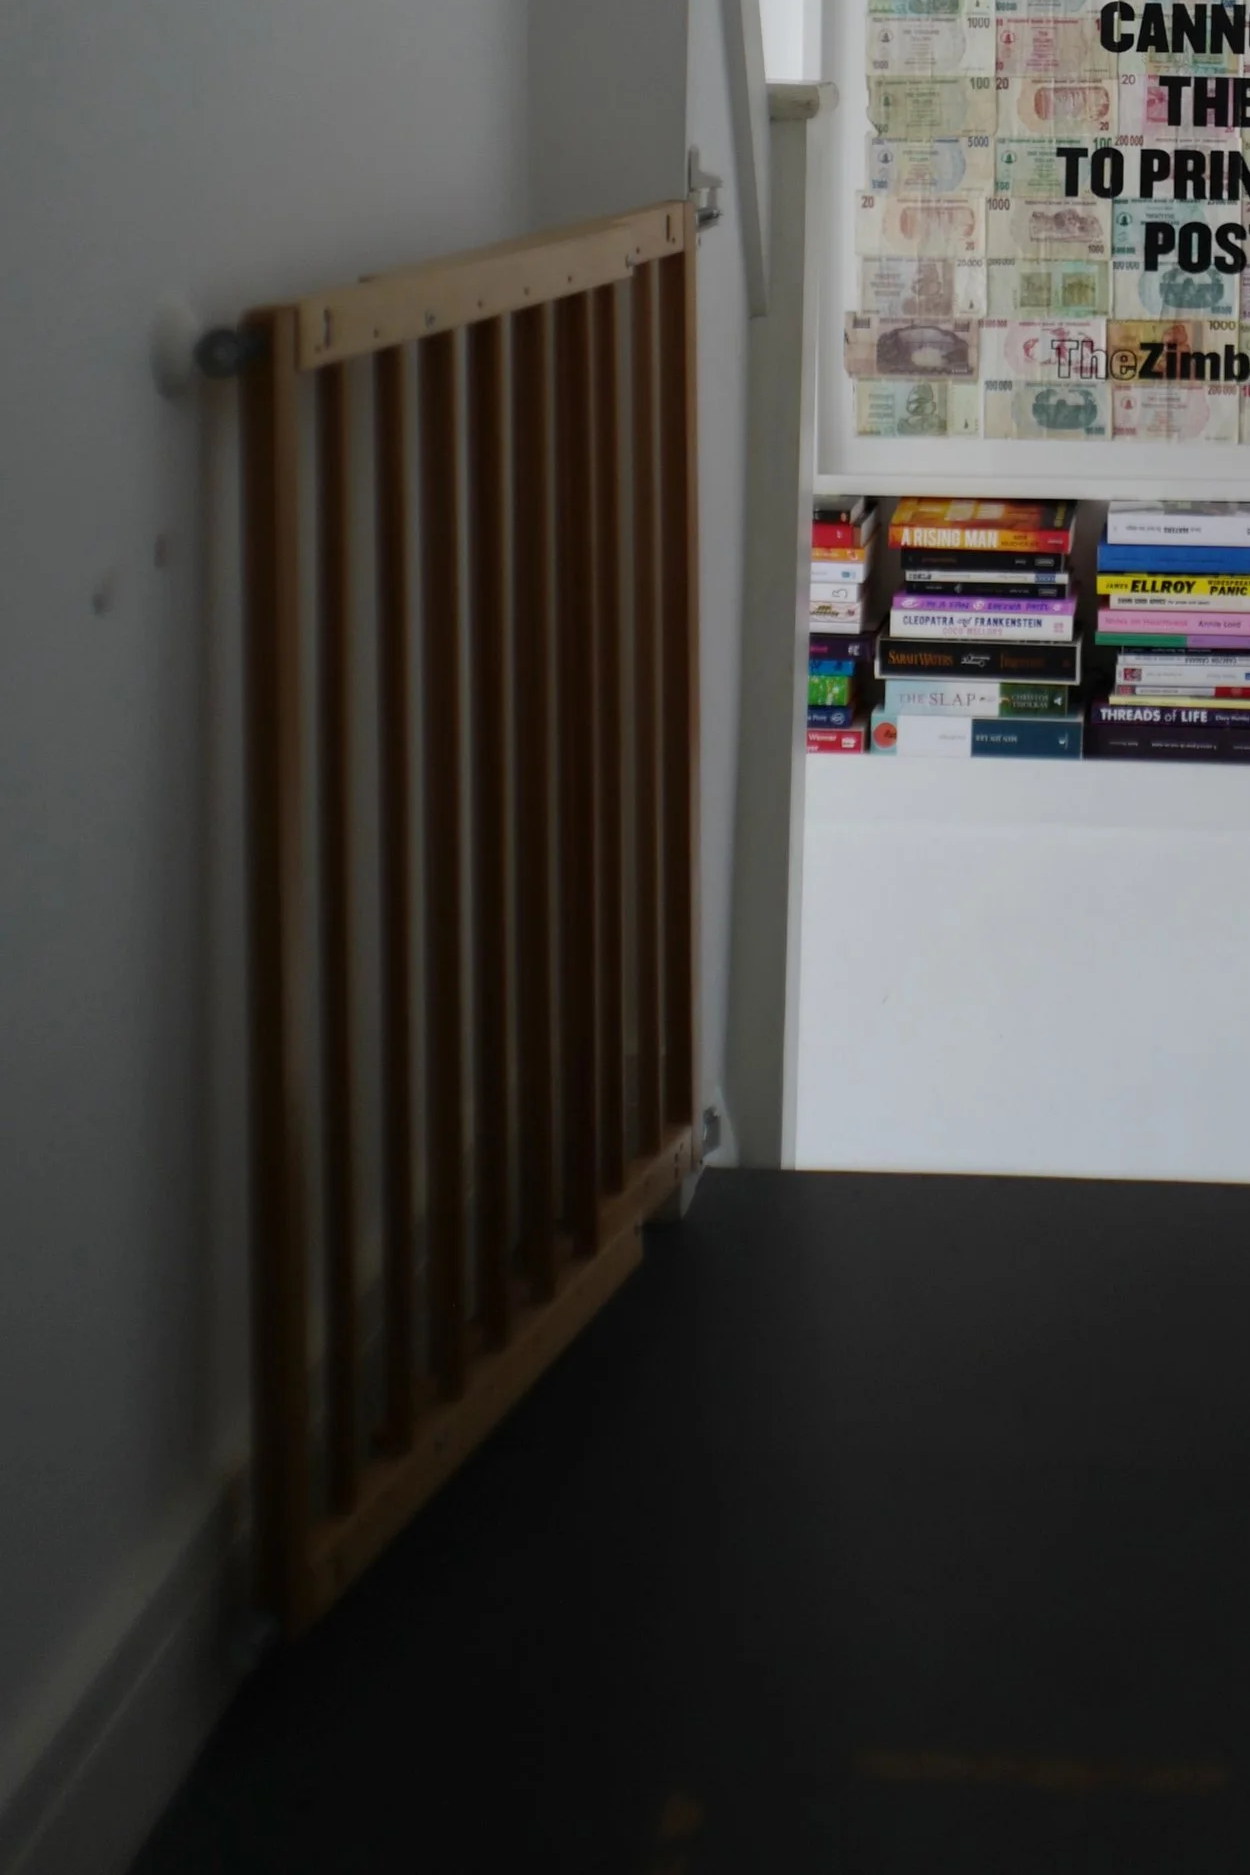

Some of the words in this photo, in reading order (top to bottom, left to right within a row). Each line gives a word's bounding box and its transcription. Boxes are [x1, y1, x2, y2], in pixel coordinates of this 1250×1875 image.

[967, 17, 990, 29] 1000
[970, 77, 990, 90] 100
[996, 78, 1009, 90] 20
[1121, 75, 1135, 86] 20
[1100, 121, 1109, 131] 20
[1056, 146, 1124, 199] TO
[862, 196, 874, 209] 20
[987, 198, 1010, 211] 1000
[1208, 320, 1235, 331] 1000
[901, 529, 911, 547] A
[913, 528, 961, 548] RISING
[965, 529, 998, 549] MAN
[1130, 580, 1197, 594] ELLROY
[1209, 586, 1248, 596] PANIC
[902, 615, 955, 626] CLEOPATRA
[974, 617, 1043, 629] FRANKENSTEIN
[899, 692, 924, 704] THE
[928, 692, 976, 706] SLAP
[1100, 708, 1161, 723] THREADS
[1164, 708, 1177, 723] of
[1181, 710, 1208, 723] LIFE
